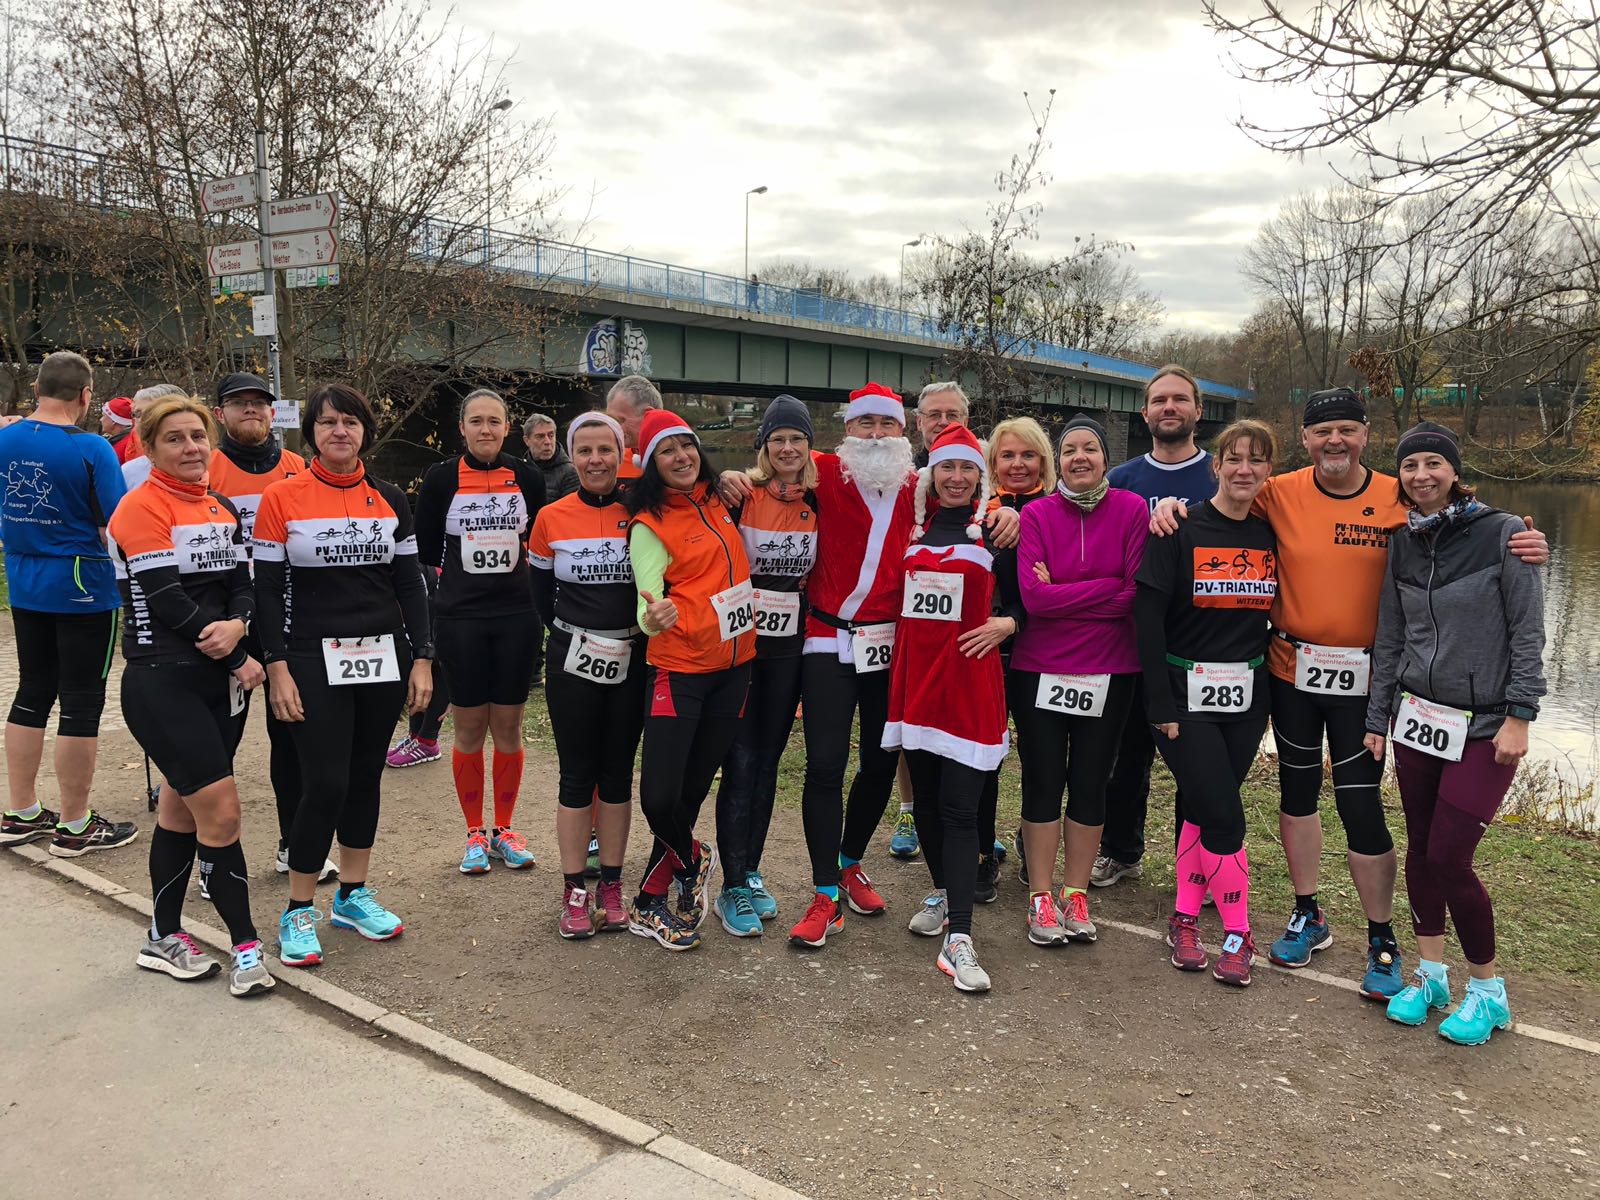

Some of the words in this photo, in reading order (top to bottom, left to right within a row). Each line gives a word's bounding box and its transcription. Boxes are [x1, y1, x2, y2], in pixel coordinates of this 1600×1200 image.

[212, 183, 235, 194] Schwerte
[218, 248, 241, 258] Dortmund
[272, 240, 290, 250] Witten
[273, 254, 291, 265] Wetter
[460, 516, 520, 527] PV-TRIATHLON
[315, 544, 389, 556] PV-TRIATHLON
[197, 559, 236, 570] WITTEN
[324, 555, 383, 564] WITTEN
[473, 549, 511, 569] 934
[577, 573, 632, 581] WITTEN
[760, 566, 807, 574] WITTEN
[912, 592, 953, 615] 290
[1236, 597, 1266, 605] WITTEN
[727, 602, 754, 633] 284
[756, 610, 792, 632] 287
[865, 644, 894, 666] 28
[339, 657, 384, 678] 297
[576, 653, 620, 680] 266
[1306, 666, 1355, 691] 279
[1048, 685, 1094, 711] 296
[1201, 685, 1244, 707] 283
[1403, 718, 1450, 752] 280
